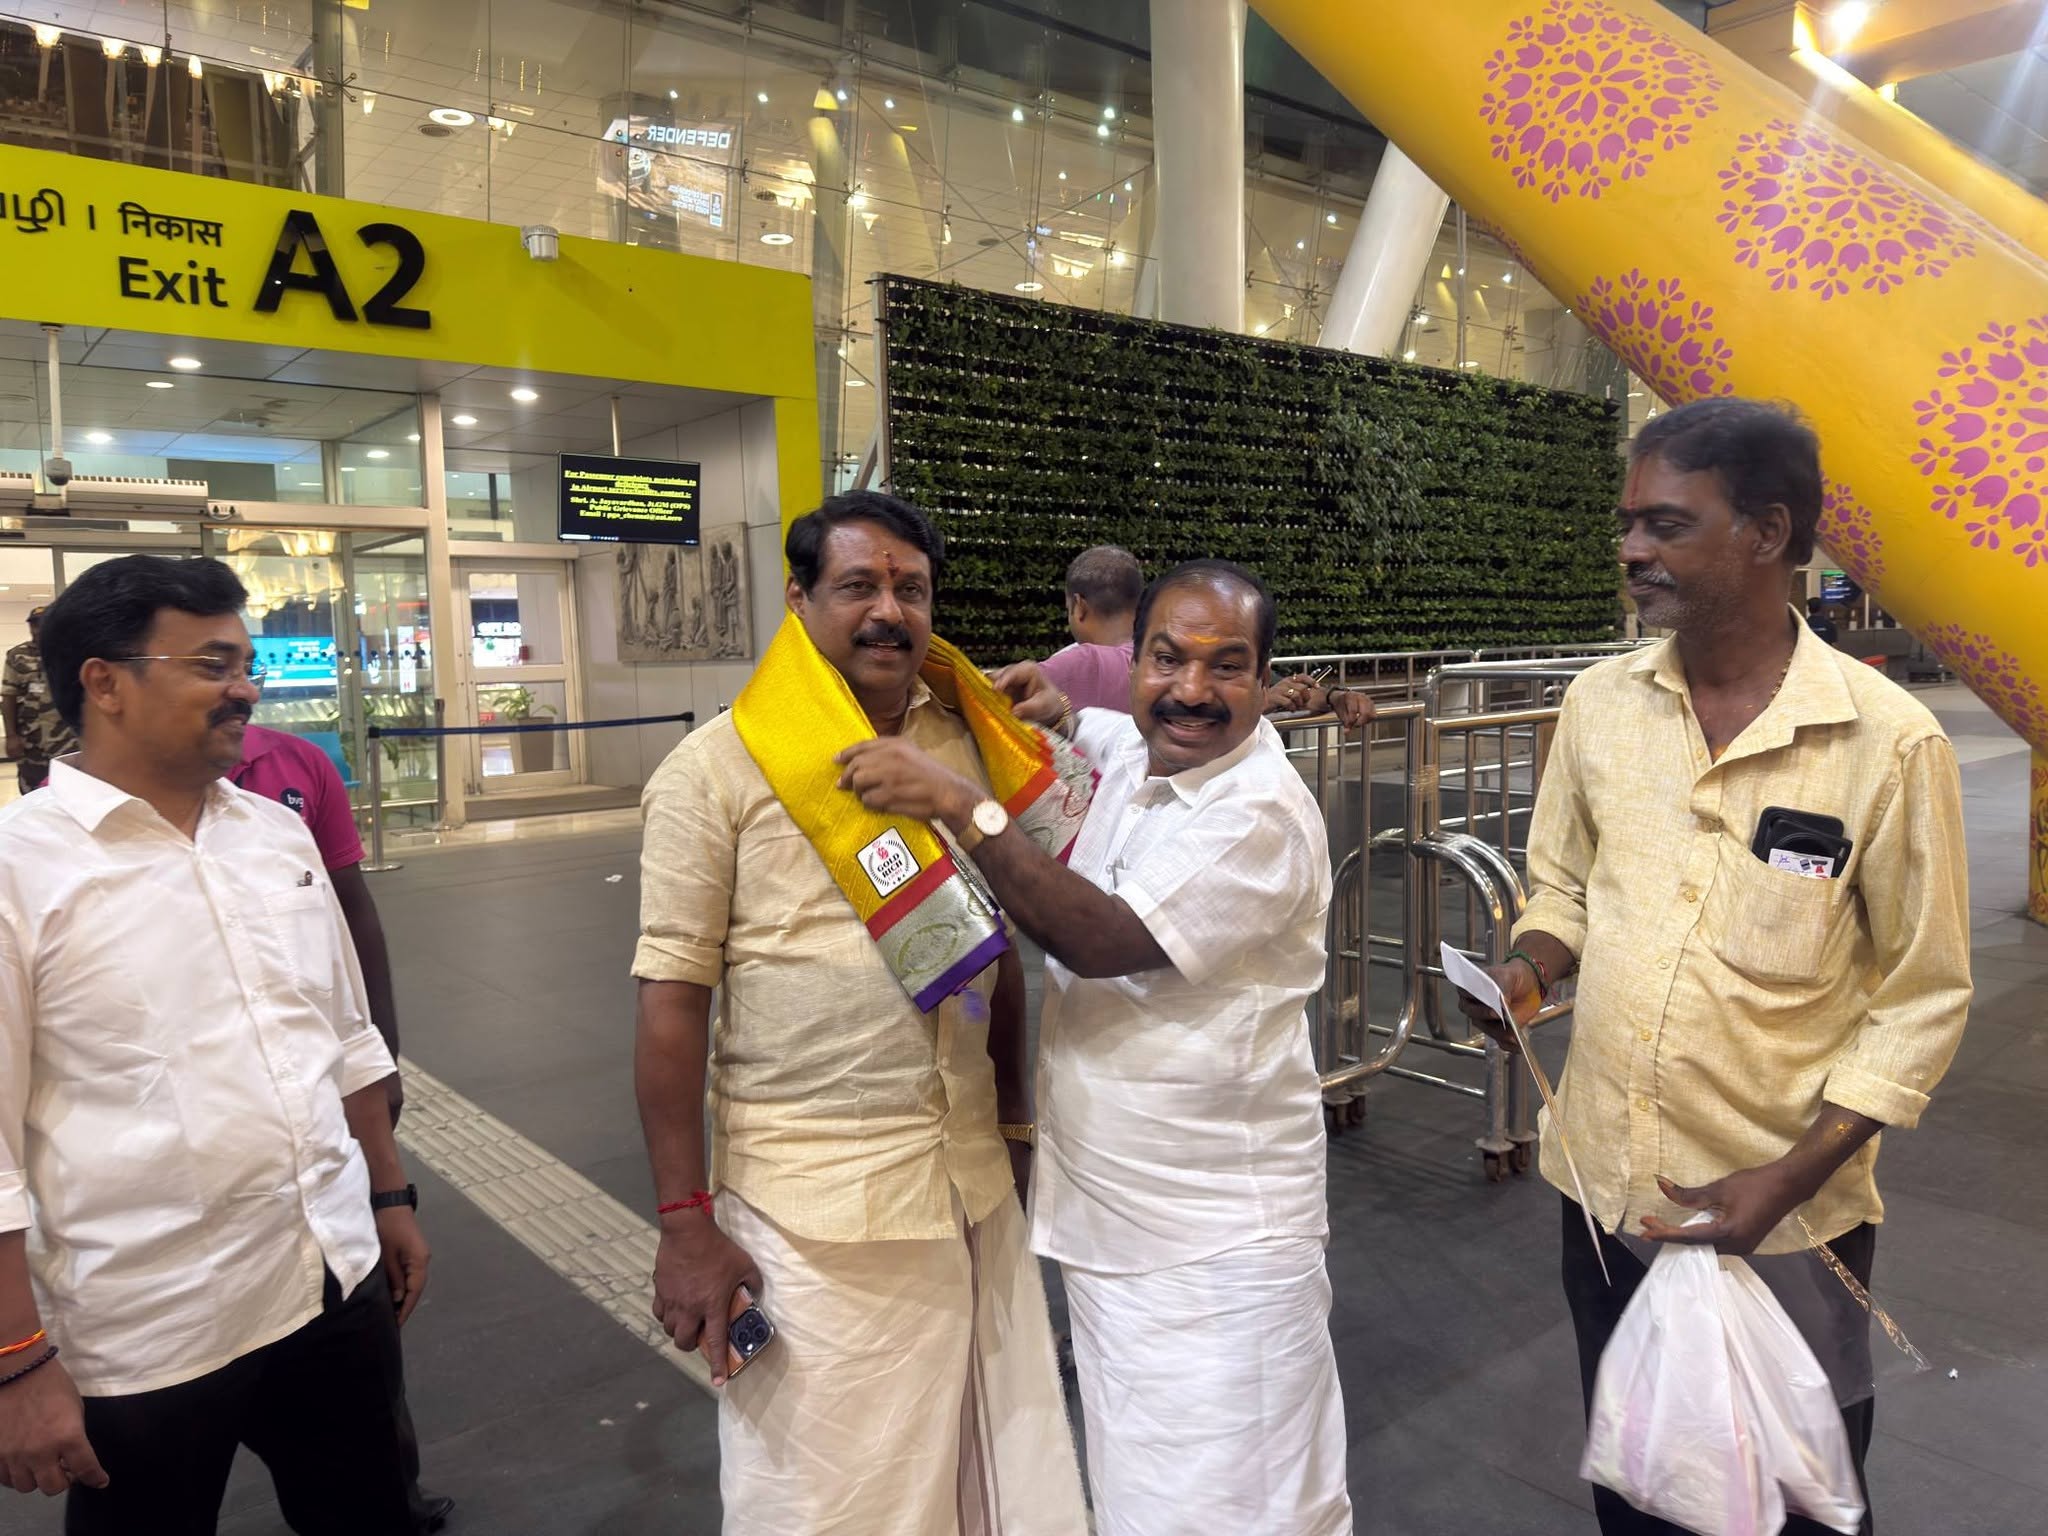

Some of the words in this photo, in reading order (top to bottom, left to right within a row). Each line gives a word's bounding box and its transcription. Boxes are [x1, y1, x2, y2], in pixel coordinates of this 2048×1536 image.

[118, 202, 224, 248] निकास
[118, 256, 229, 309] Exit
[253, 208, 431, 330] A2
[877, 852, 900, 872] GOLD
[882, 859, 903, 878] RICH
